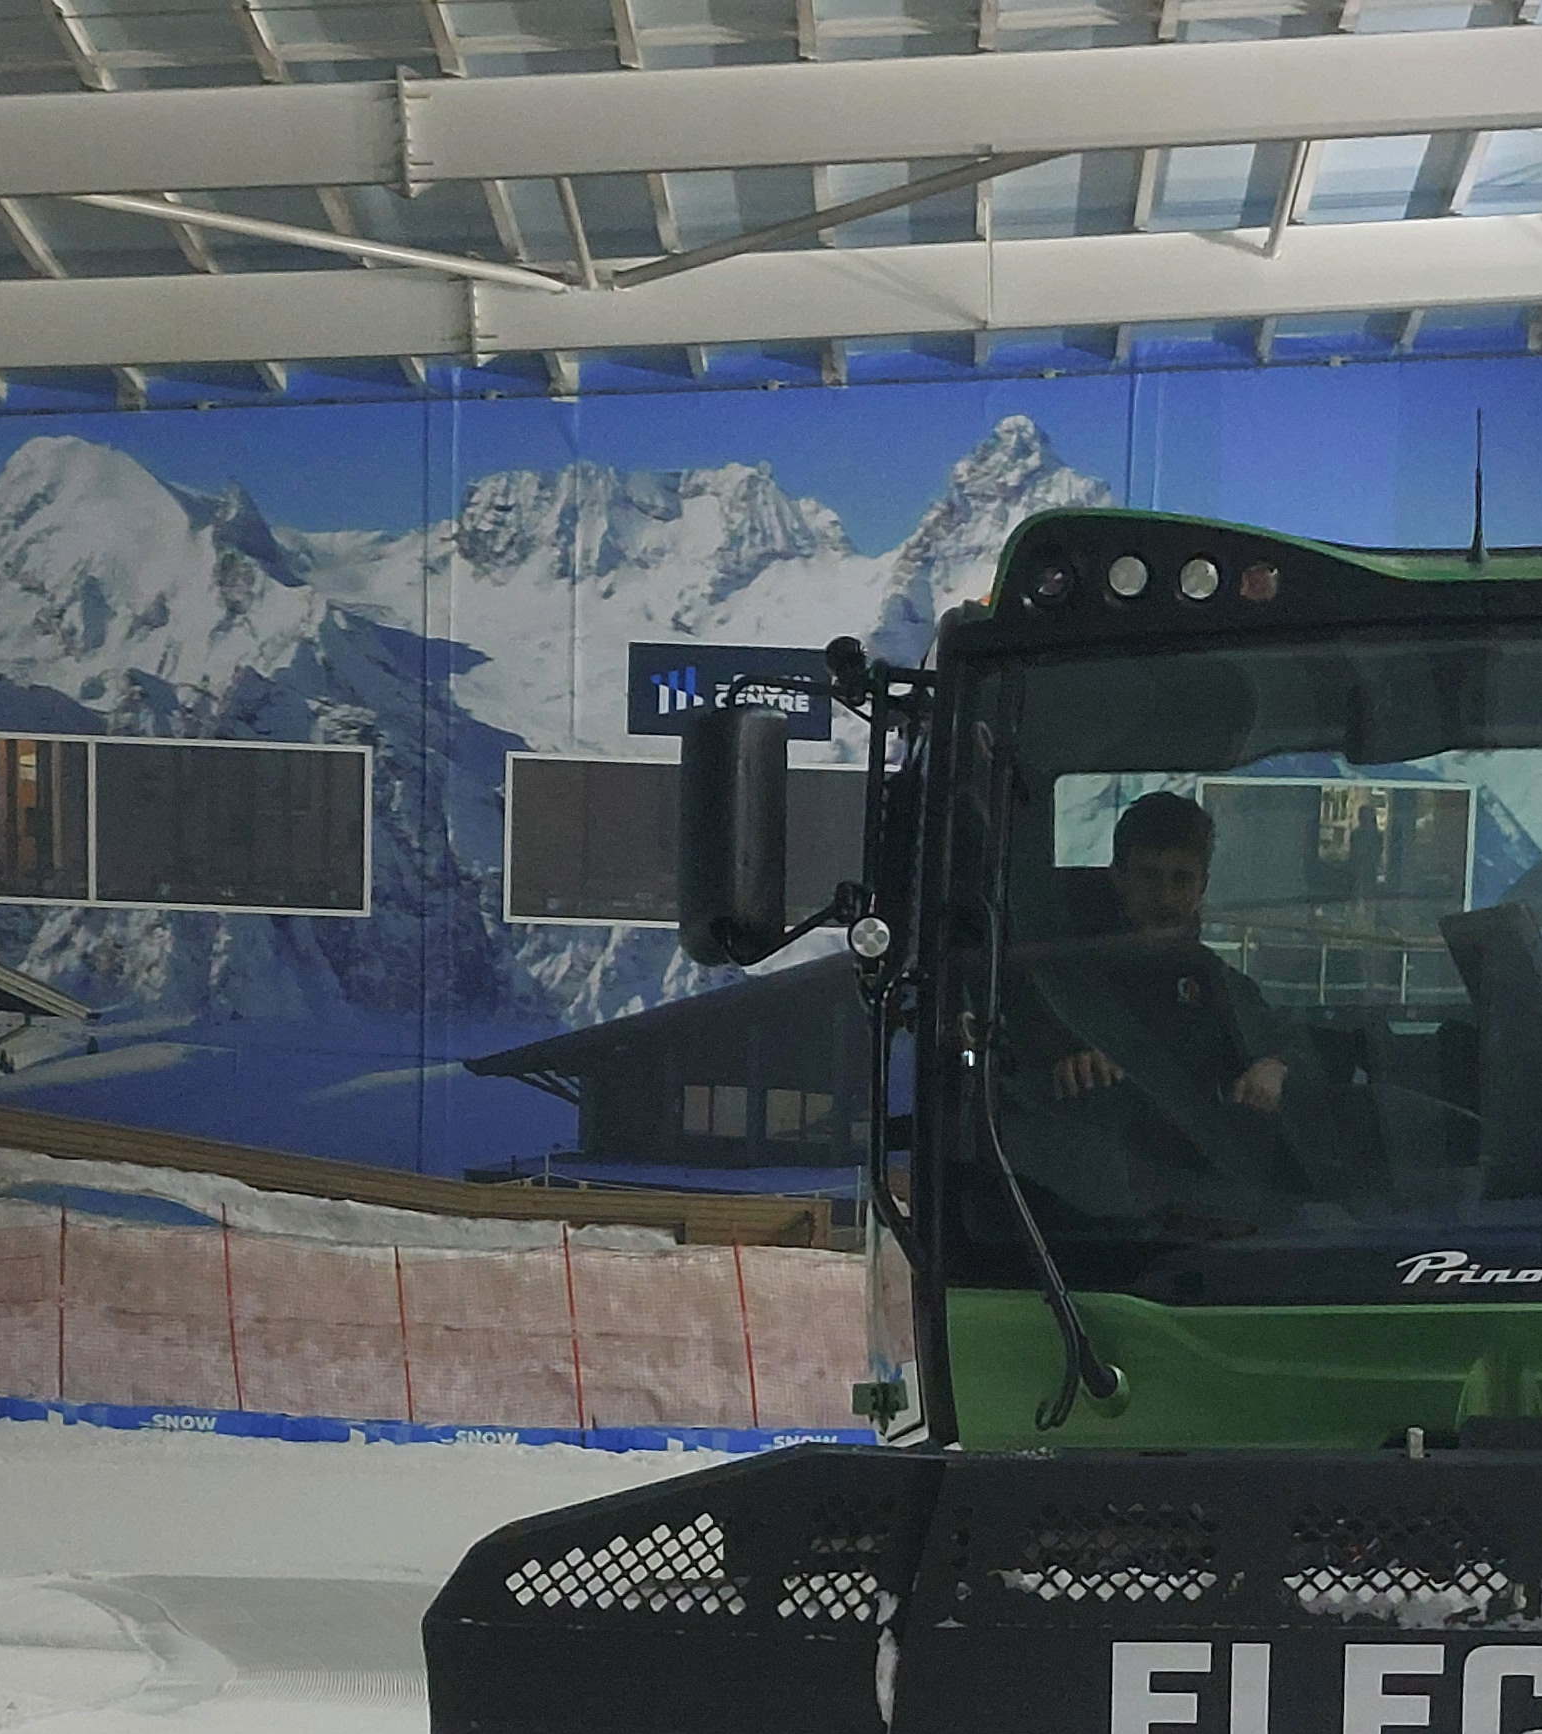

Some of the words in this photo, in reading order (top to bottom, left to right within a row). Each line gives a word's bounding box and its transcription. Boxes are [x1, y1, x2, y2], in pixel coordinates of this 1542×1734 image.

[714, 691, 810, 713] CENTRE
[151, 1413, 218, 1431] SNOW
[454, 1429, 520, 1445] SNOW
